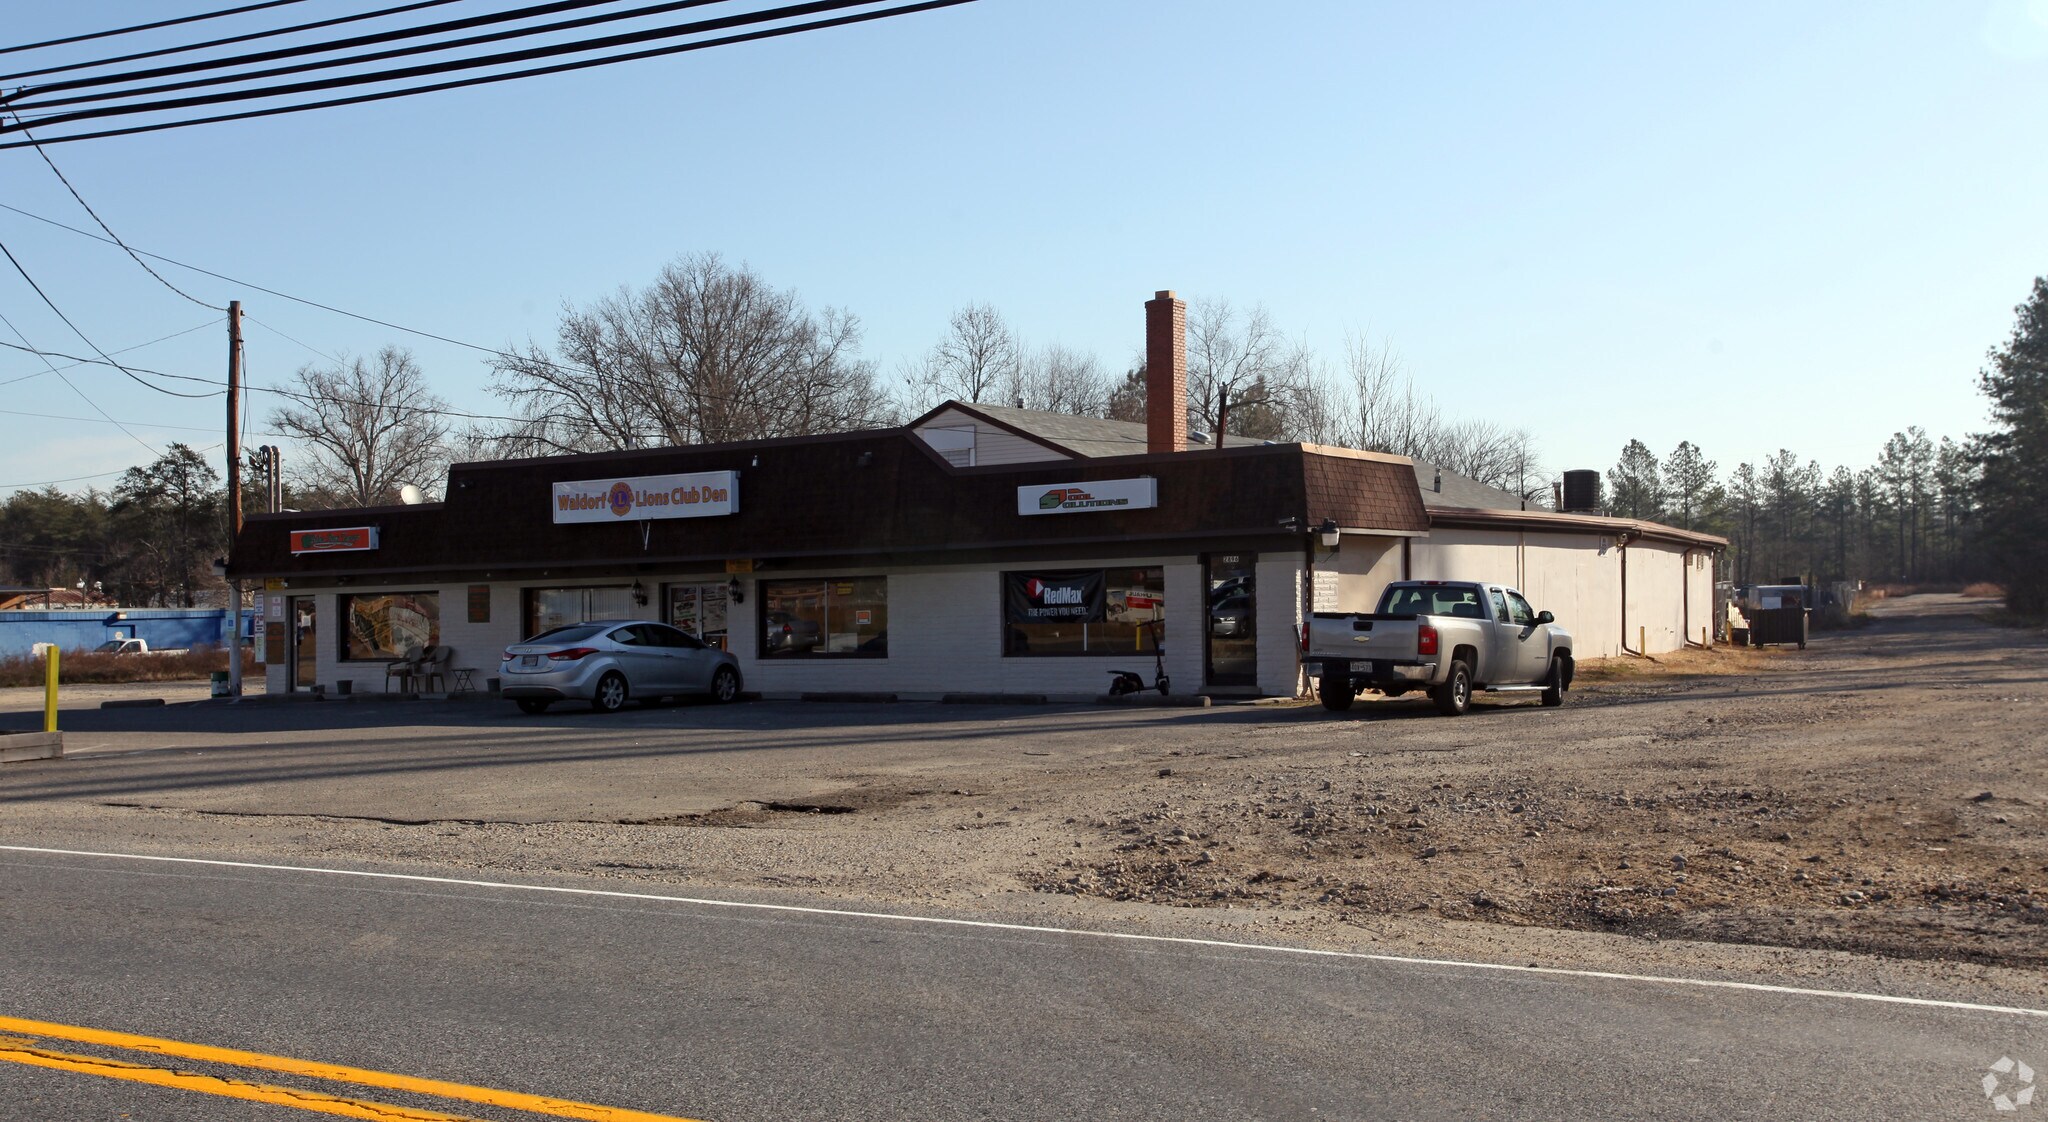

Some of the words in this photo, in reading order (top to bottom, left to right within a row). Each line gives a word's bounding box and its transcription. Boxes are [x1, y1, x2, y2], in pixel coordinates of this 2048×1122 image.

[557, 492, 606, 511] Waldorf
[635, 490, 669, 507] Lions
[671, 487, 701, 505] Club
[702, 486, 728, 503] Den
[1043, 586, 1083, 605] RedMax
[1027, 608, 1038, 617] THE
[1039, 607, 1057, 617] POWER
[1058, 607, 1070, 616] YOU
